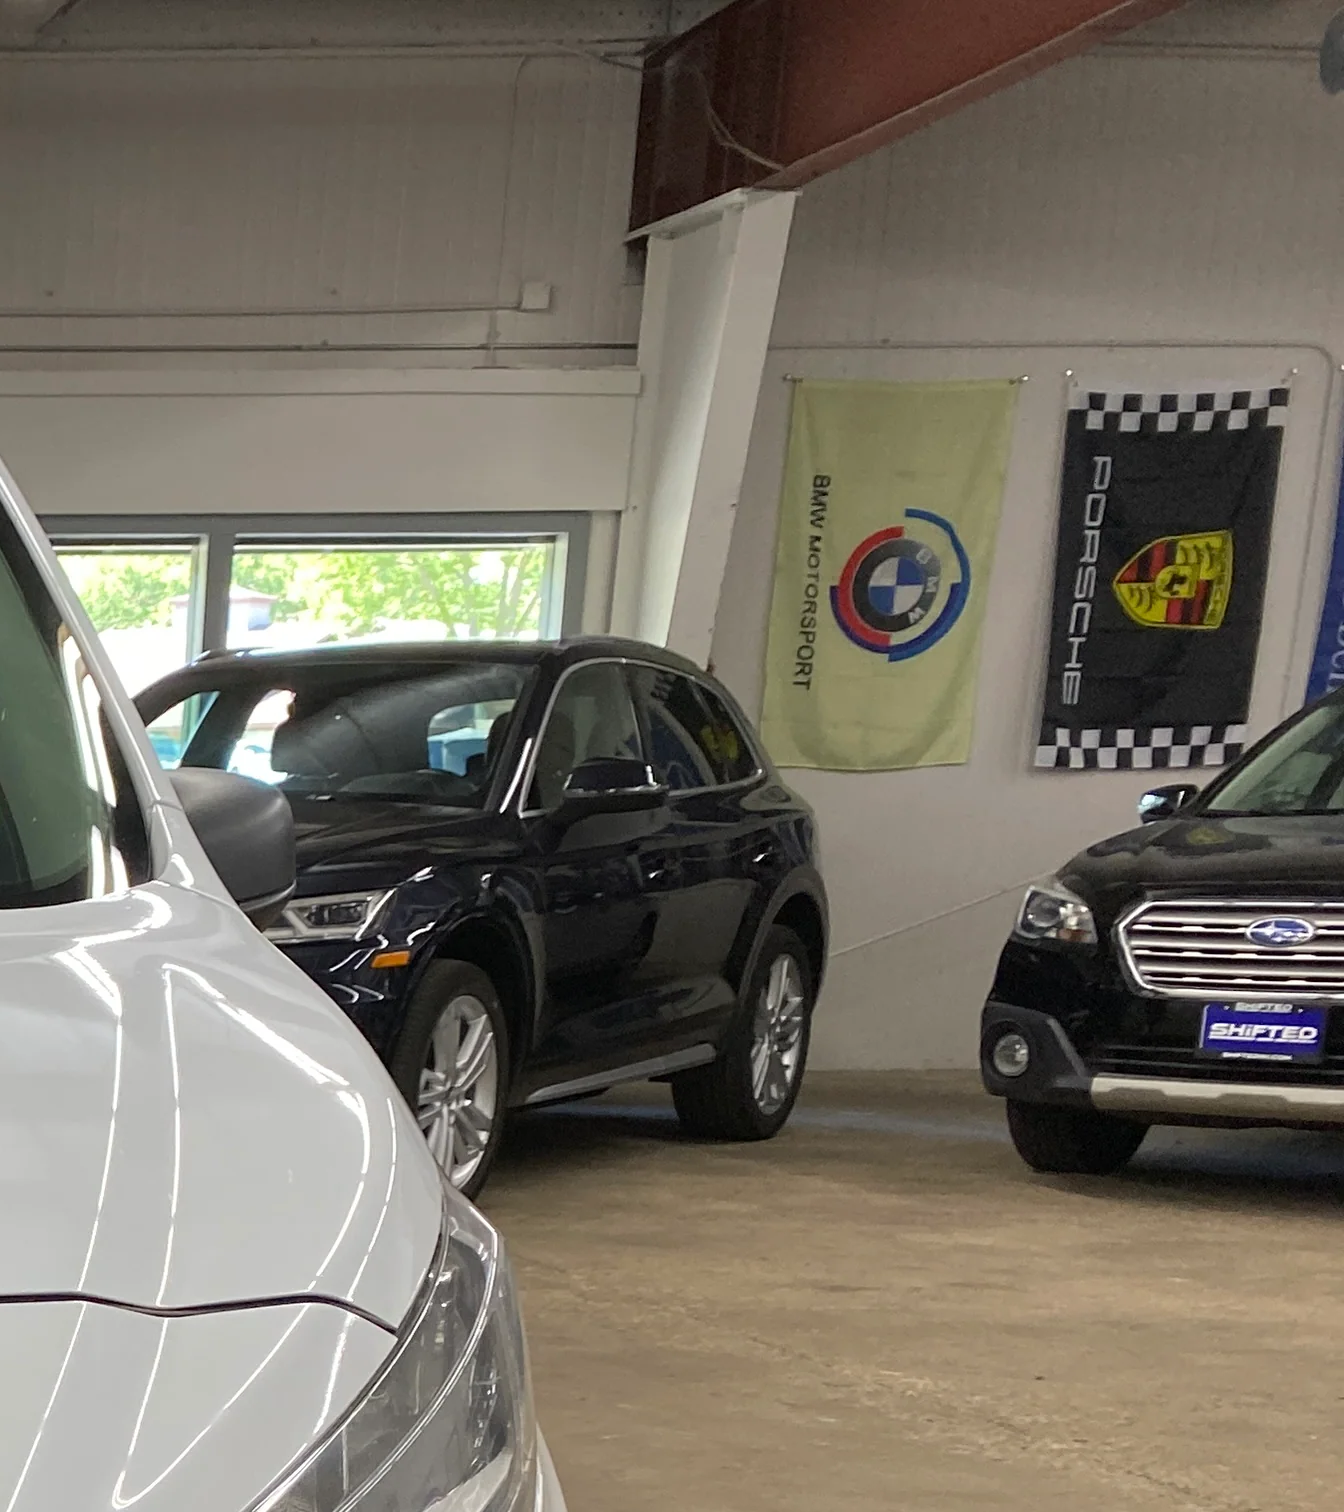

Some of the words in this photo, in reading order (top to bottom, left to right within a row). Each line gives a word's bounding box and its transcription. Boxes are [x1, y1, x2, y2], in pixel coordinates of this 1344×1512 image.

[810, 474, 831, 529] BMW
[792, 535, 822, 691] MOTORSPORT
[908, 548, 940, 624] BMW
[1063, 456, 1112, 705] PORSCHE
